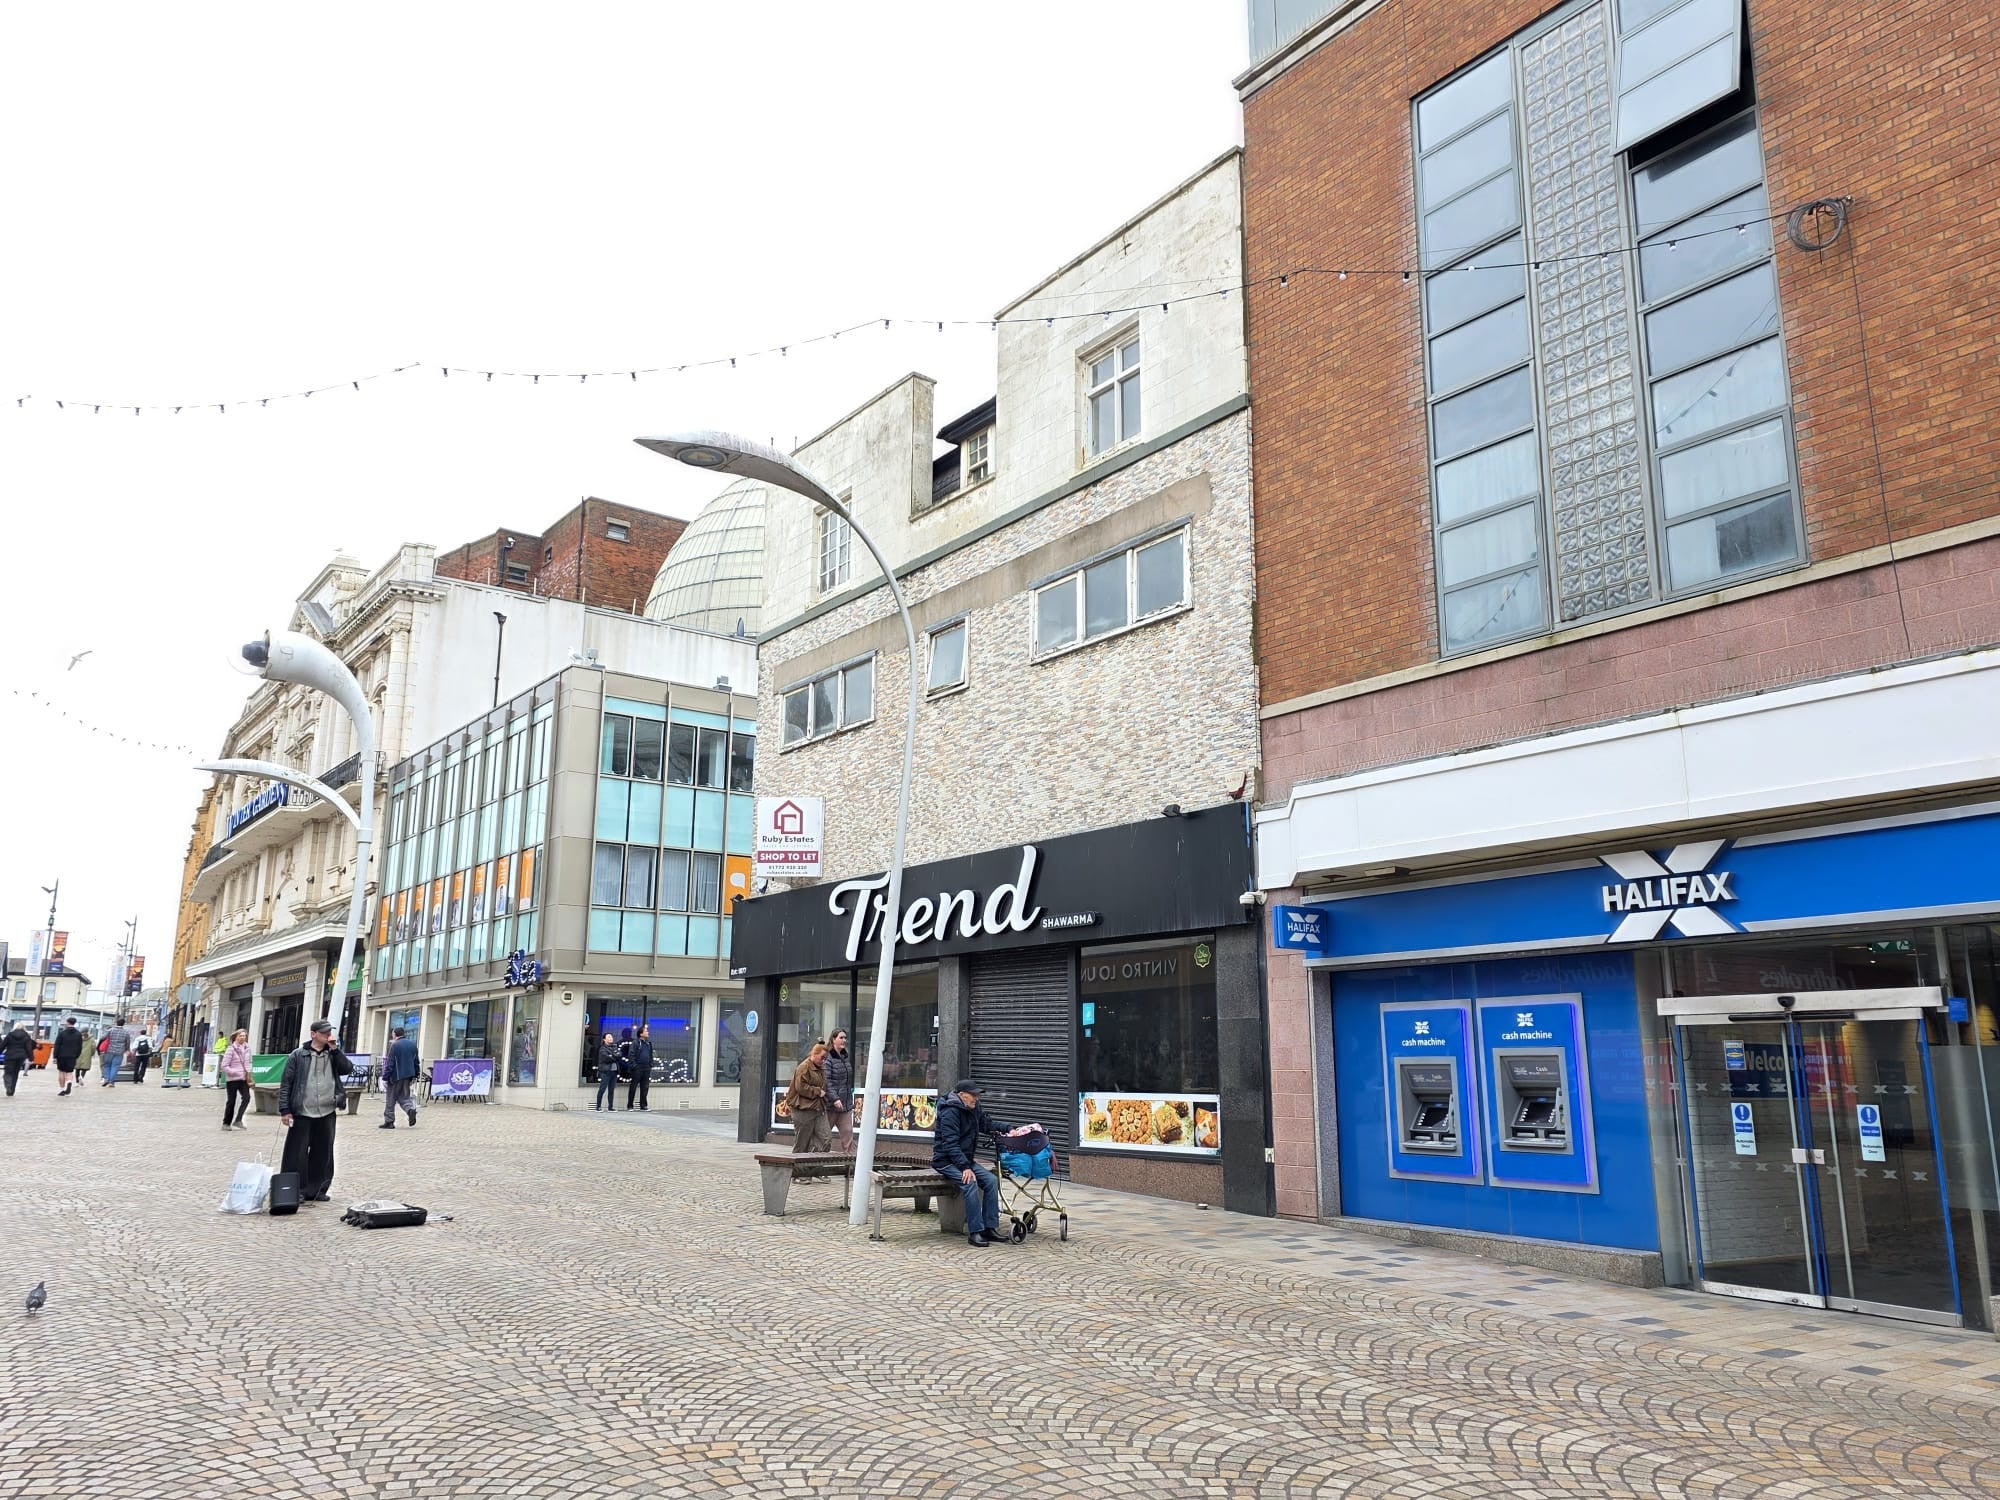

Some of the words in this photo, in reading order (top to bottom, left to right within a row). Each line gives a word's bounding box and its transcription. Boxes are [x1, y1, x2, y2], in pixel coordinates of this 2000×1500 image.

[762, 835, 783, 844] Ruby
[784, 835, 815, 843] Estates
[760, 853, 785, 861] SHOP
[787, 853, 800, 861] TO
[802, 853, 817, 861] LET
[1602, 871, 1732, 912] HALIFAX
[1042, 913, 1093, 928] SHAWARMA
[1287, 922, 1320, 934] HALIFAX
[1501, 1032, 1519, 1041] cash
[1519, 1030, 1553, 1040] machine
[1401, 1038, 1417, 1046] cash
[1417, 1037, 1446, 1046] machine
